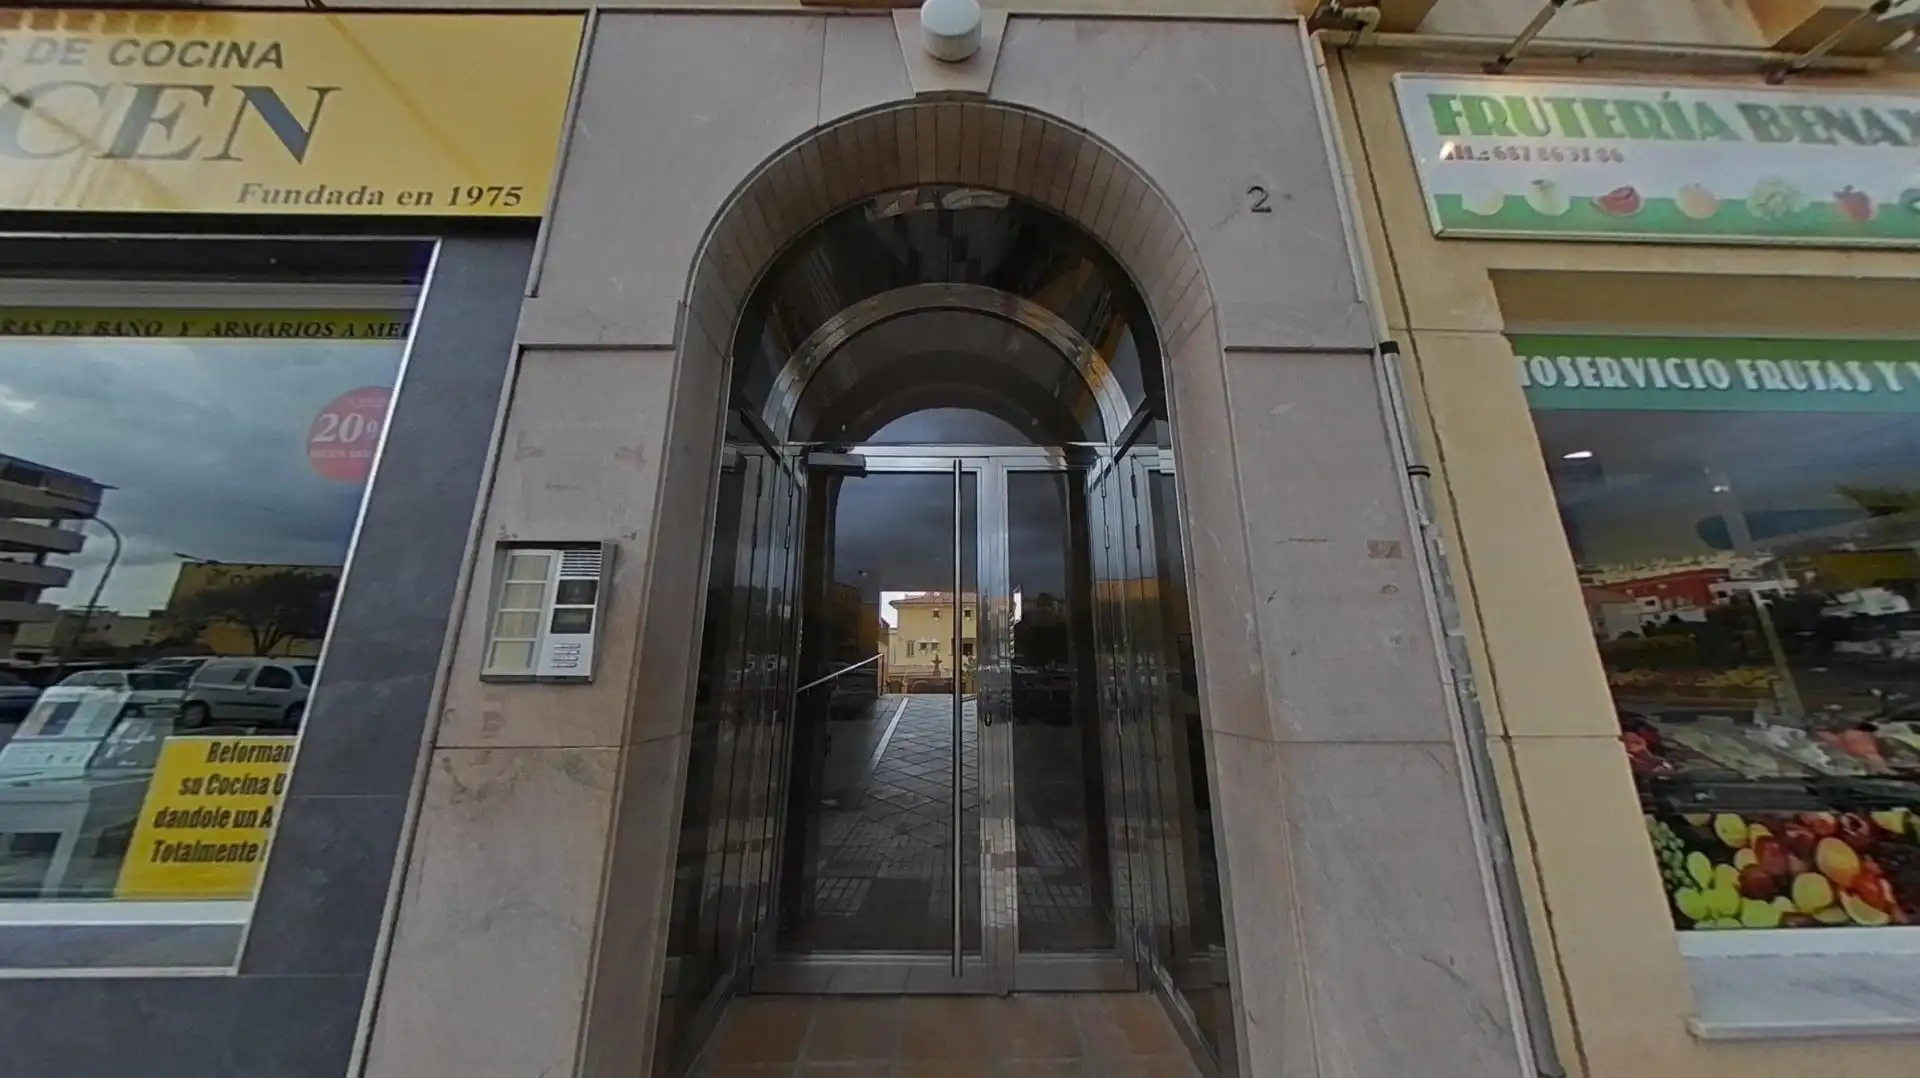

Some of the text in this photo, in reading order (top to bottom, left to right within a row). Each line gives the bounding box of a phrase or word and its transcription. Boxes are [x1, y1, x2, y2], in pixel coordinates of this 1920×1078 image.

[25, 37, 92, 66] DE
[108, 39, 284, 70] COCINA
[1428, 91, 1741, 142] FRUTERÍA
[236, 182, 525, 208] Fundada en 1975
[1245, 185, 1273, 213] 2
[50, 320, 84, 336] DE
[94, 317, 162, 337] BAÑO
[178, 321, 198, 337] Y
[206, 321, 336, 337] ARMARIOS
[341, 321, 357, 337] A
[1735, 357, 1873, 392] FRUTAS
[1872, 359, 1905, 392] Y
[179, 778, 200, 796] su
[206, 773, 269, 796] Cocina
[153, 806, 274, 830] dandole un A
[151, 839, 256, 863] Totalmente
